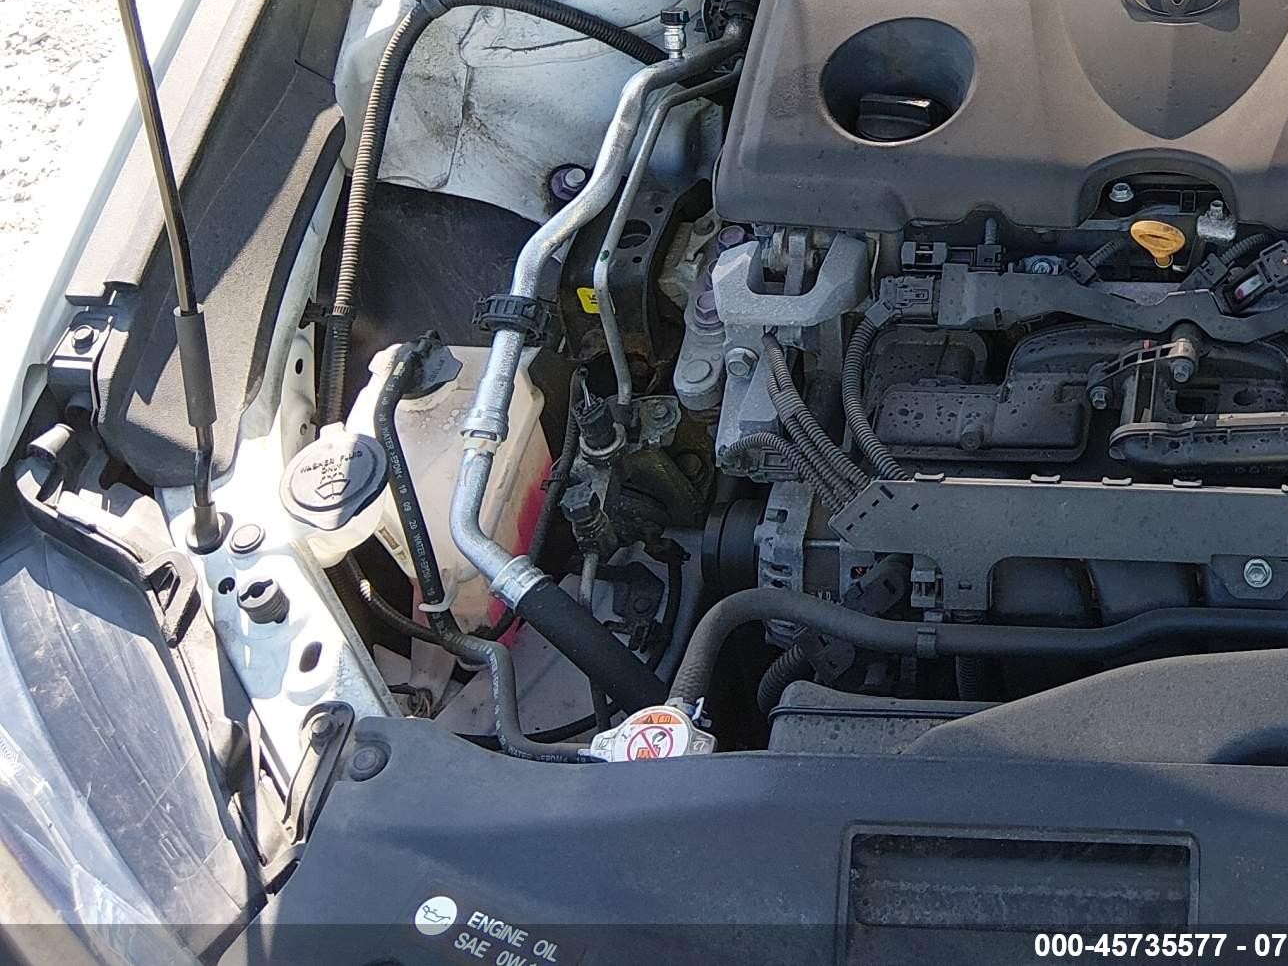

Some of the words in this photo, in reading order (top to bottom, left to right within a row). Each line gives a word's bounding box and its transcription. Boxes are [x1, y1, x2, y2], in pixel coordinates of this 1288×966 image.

[454, 932, 492, 958] SAE
[496, 950, 537, 966] 0W
[467, 911, 529, 948] ENGINE
[533, 939, 558, 963] OIL
